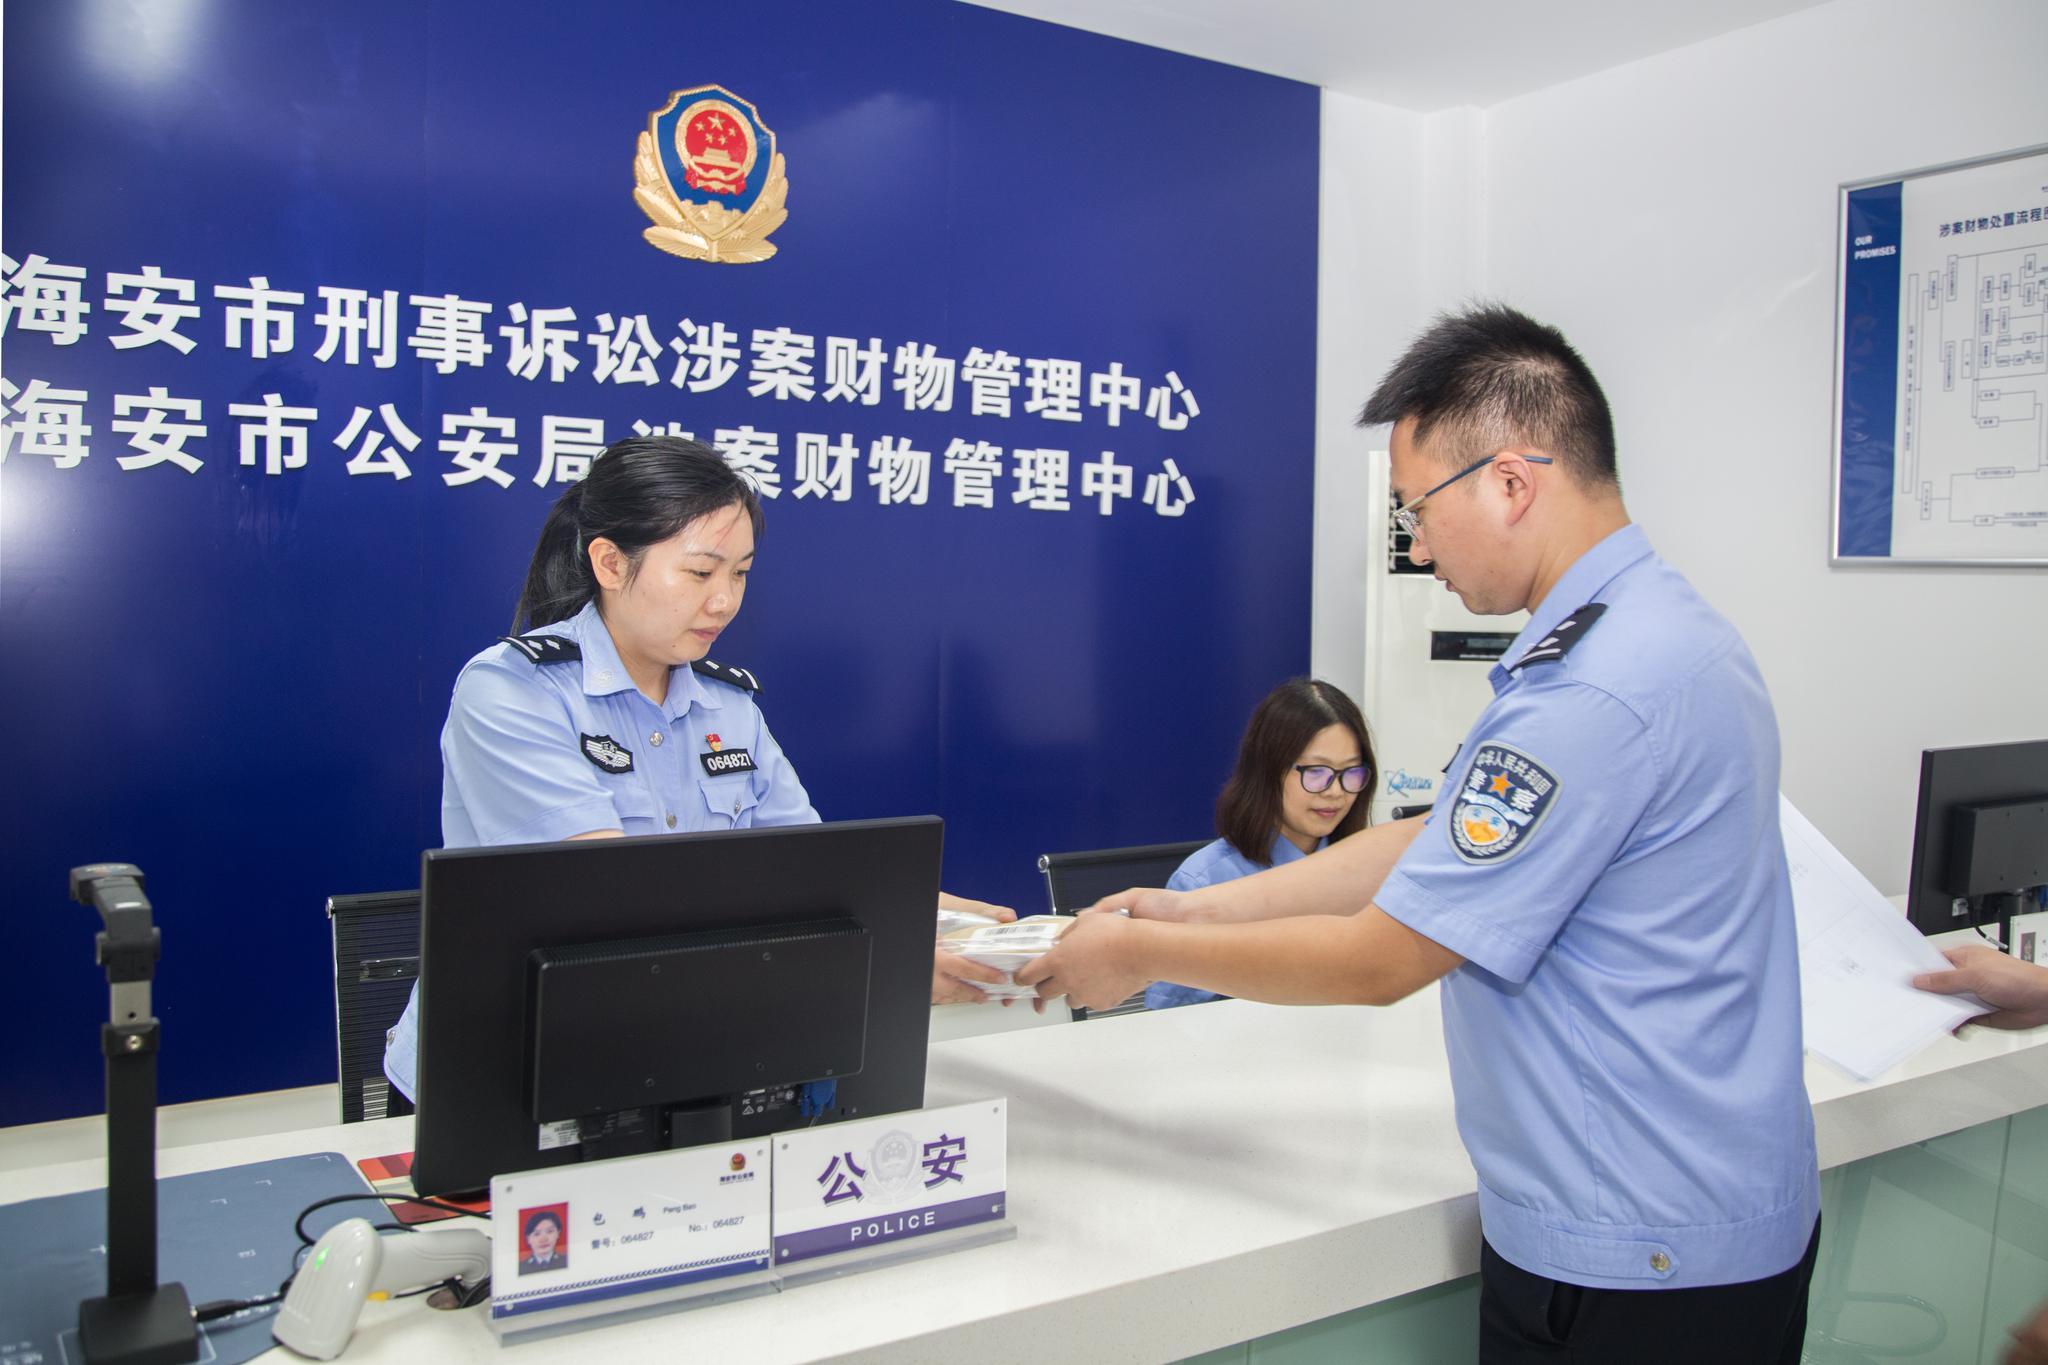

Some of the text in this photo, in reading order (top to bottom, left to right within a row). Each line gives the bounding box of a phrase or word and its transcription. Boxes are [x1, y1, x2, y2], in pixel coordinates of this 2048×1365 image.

[1854, 235, 1873, 246] OUR
[1854, 245, 1897, 260] PROMISES
[2, 254, 1200, 431] 海安市刑事诉讼涉案财物管理中心
[707, 753, 751, 771] 064827
[712, 1216, 745, 1229] 064827
[850, 1211, 936, 1241] POLICE
[620, 1231, 654, 1245] 064827
